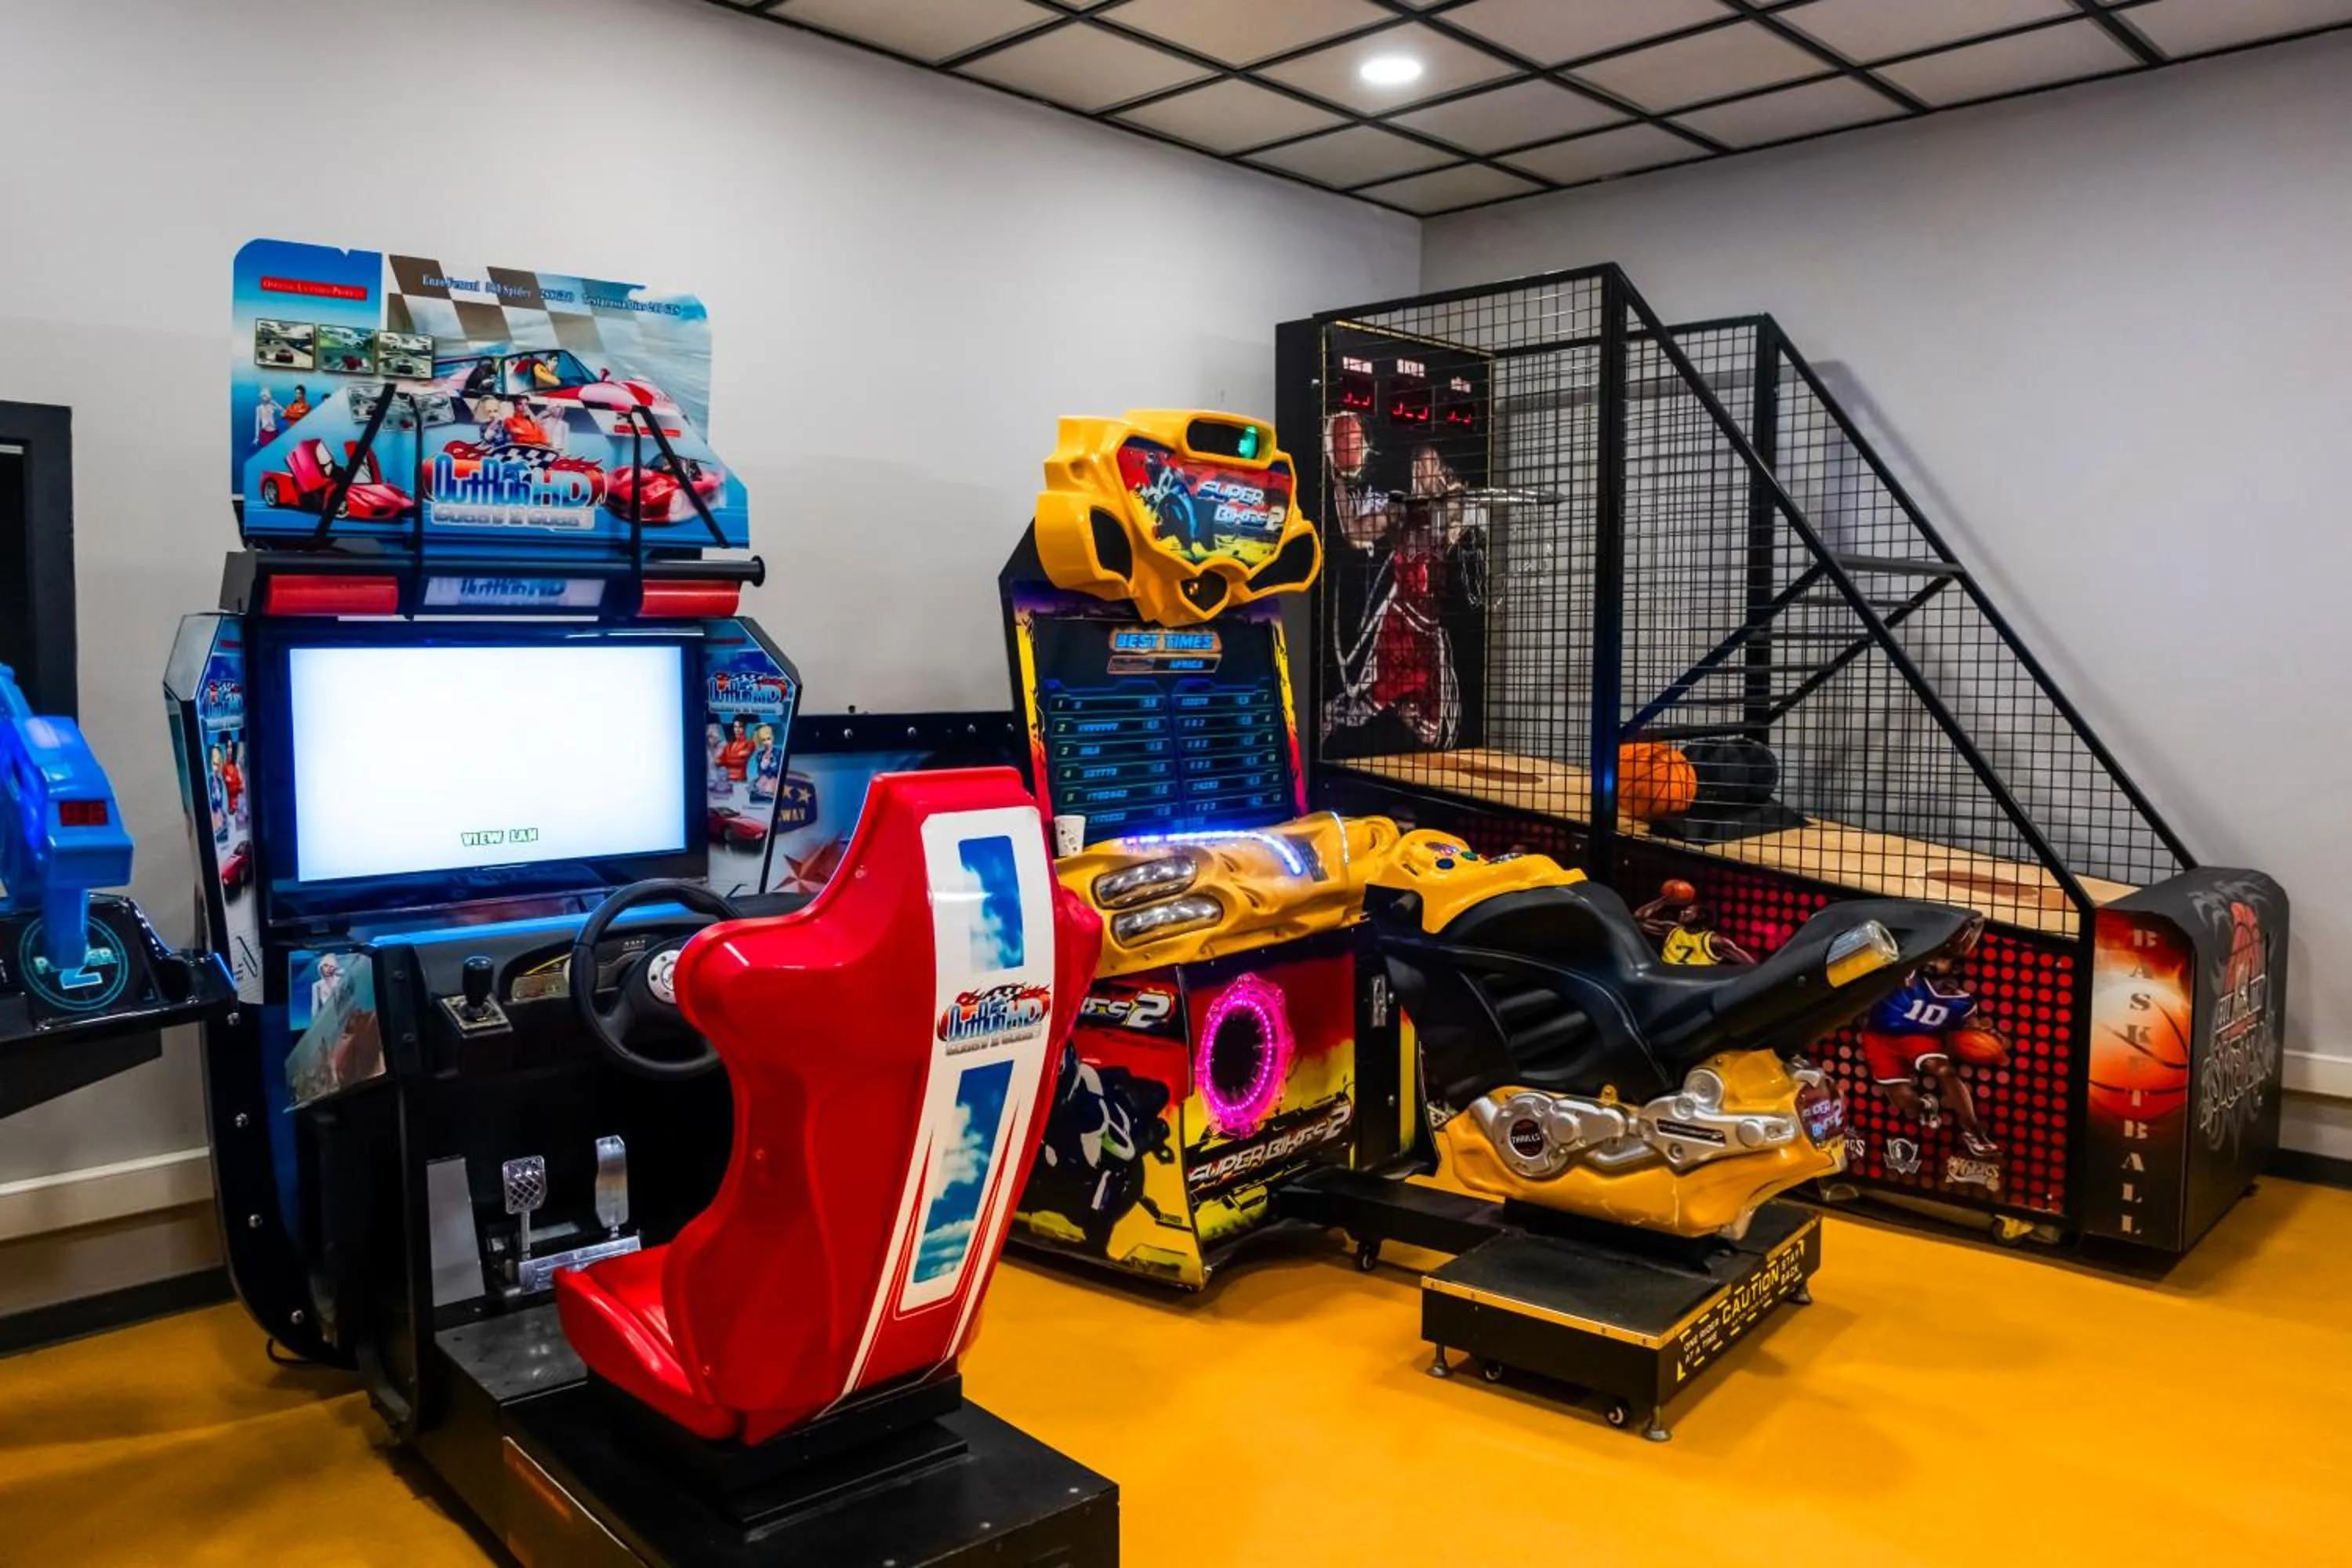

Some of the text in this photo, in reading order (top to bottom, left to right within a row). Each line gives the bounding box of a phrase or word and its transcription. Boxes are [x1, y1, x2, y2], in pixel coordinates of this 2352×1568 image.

[1196, 480, 1265, 506] SUPER
[1265, 504, 1286, 531] 2
[1116, 633, 1214, 649] BEST TIMES
[460, 830, 504, 847] VIEW
[1127, 993, 1170, 1029] 2
[1903, 999, 1949, 1026] 10
[1188, 1102, 1352, 1182] SUPER BIKES 2
[1780, 1263, 1799, 1286] BACK
[1722, 1265, 1779, 1324] CAUTION
[1683, 1334, 1699, 1352] ONE
